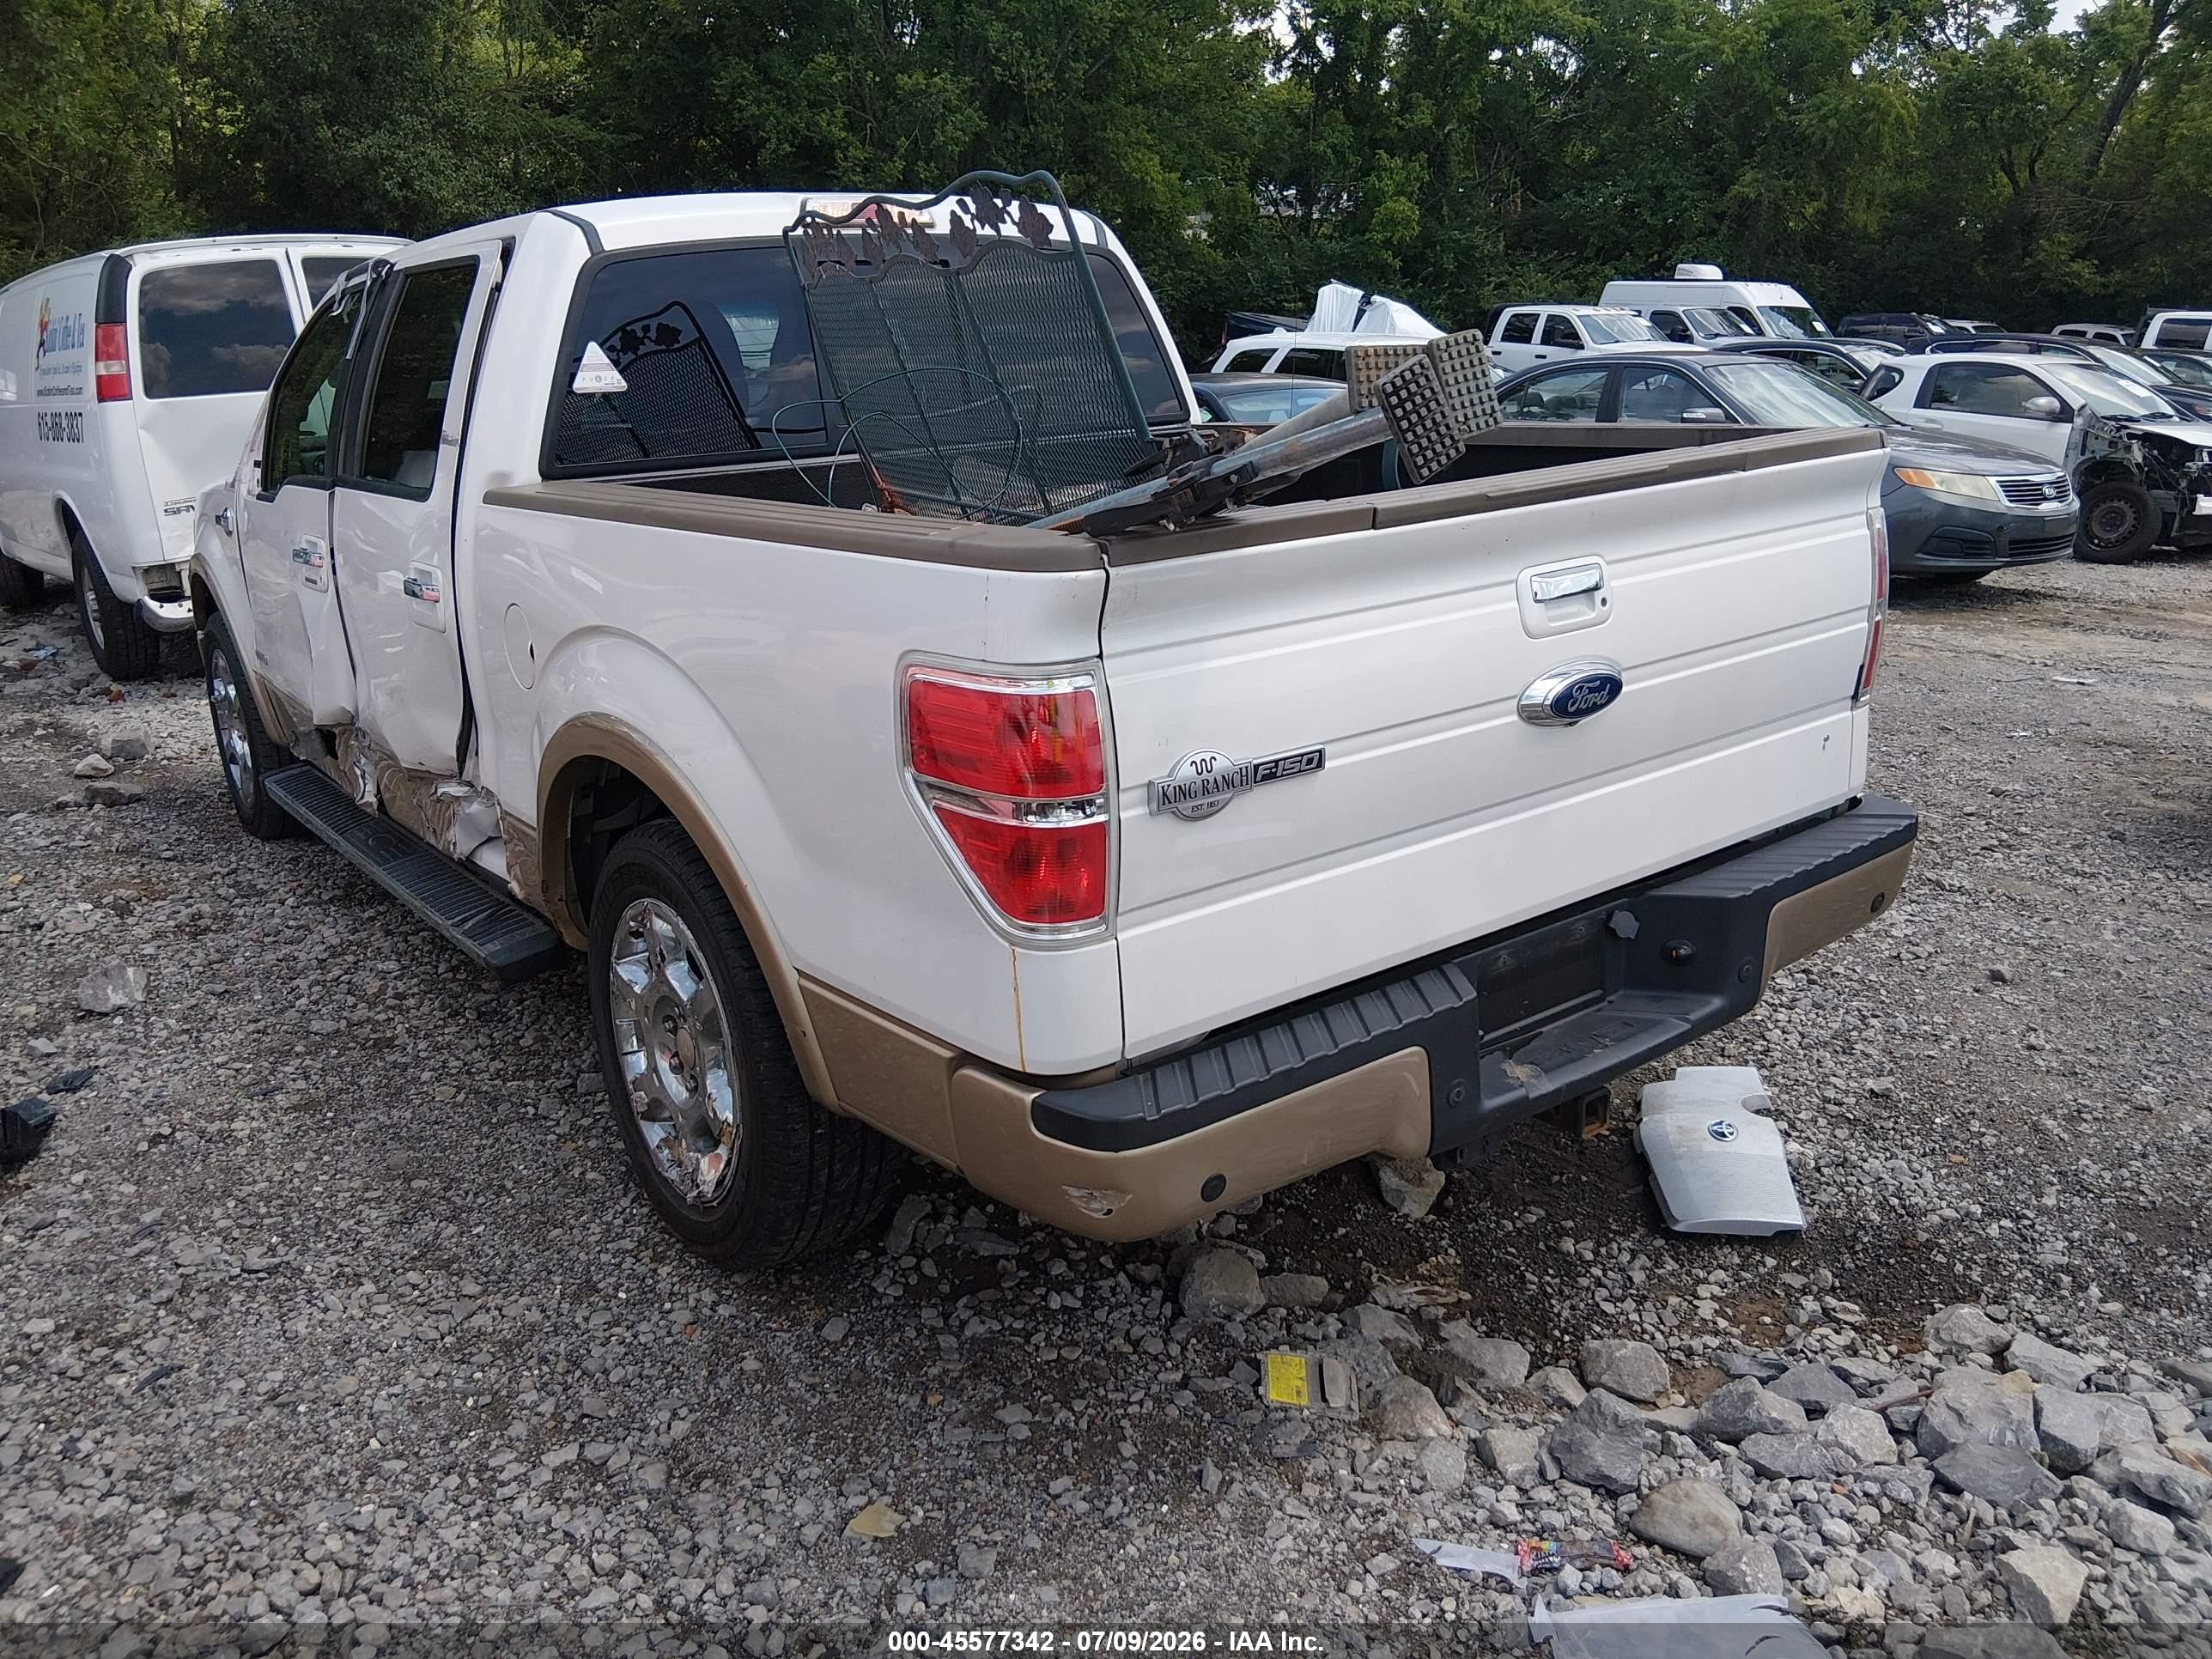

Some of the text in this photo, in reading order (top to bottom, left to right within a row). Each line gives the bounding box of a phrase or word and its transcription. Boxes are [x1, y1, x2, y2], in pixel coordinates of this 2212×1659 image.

[38, 411, 84, 443] 615-868-3837
[1567, 680, 1612, 713] Ford
[1255, 751, 1321, 782] F-150
[1160, 764, 1250, 806] KING RANCH
[1190, 799, 1220, 813] EST. 1853
